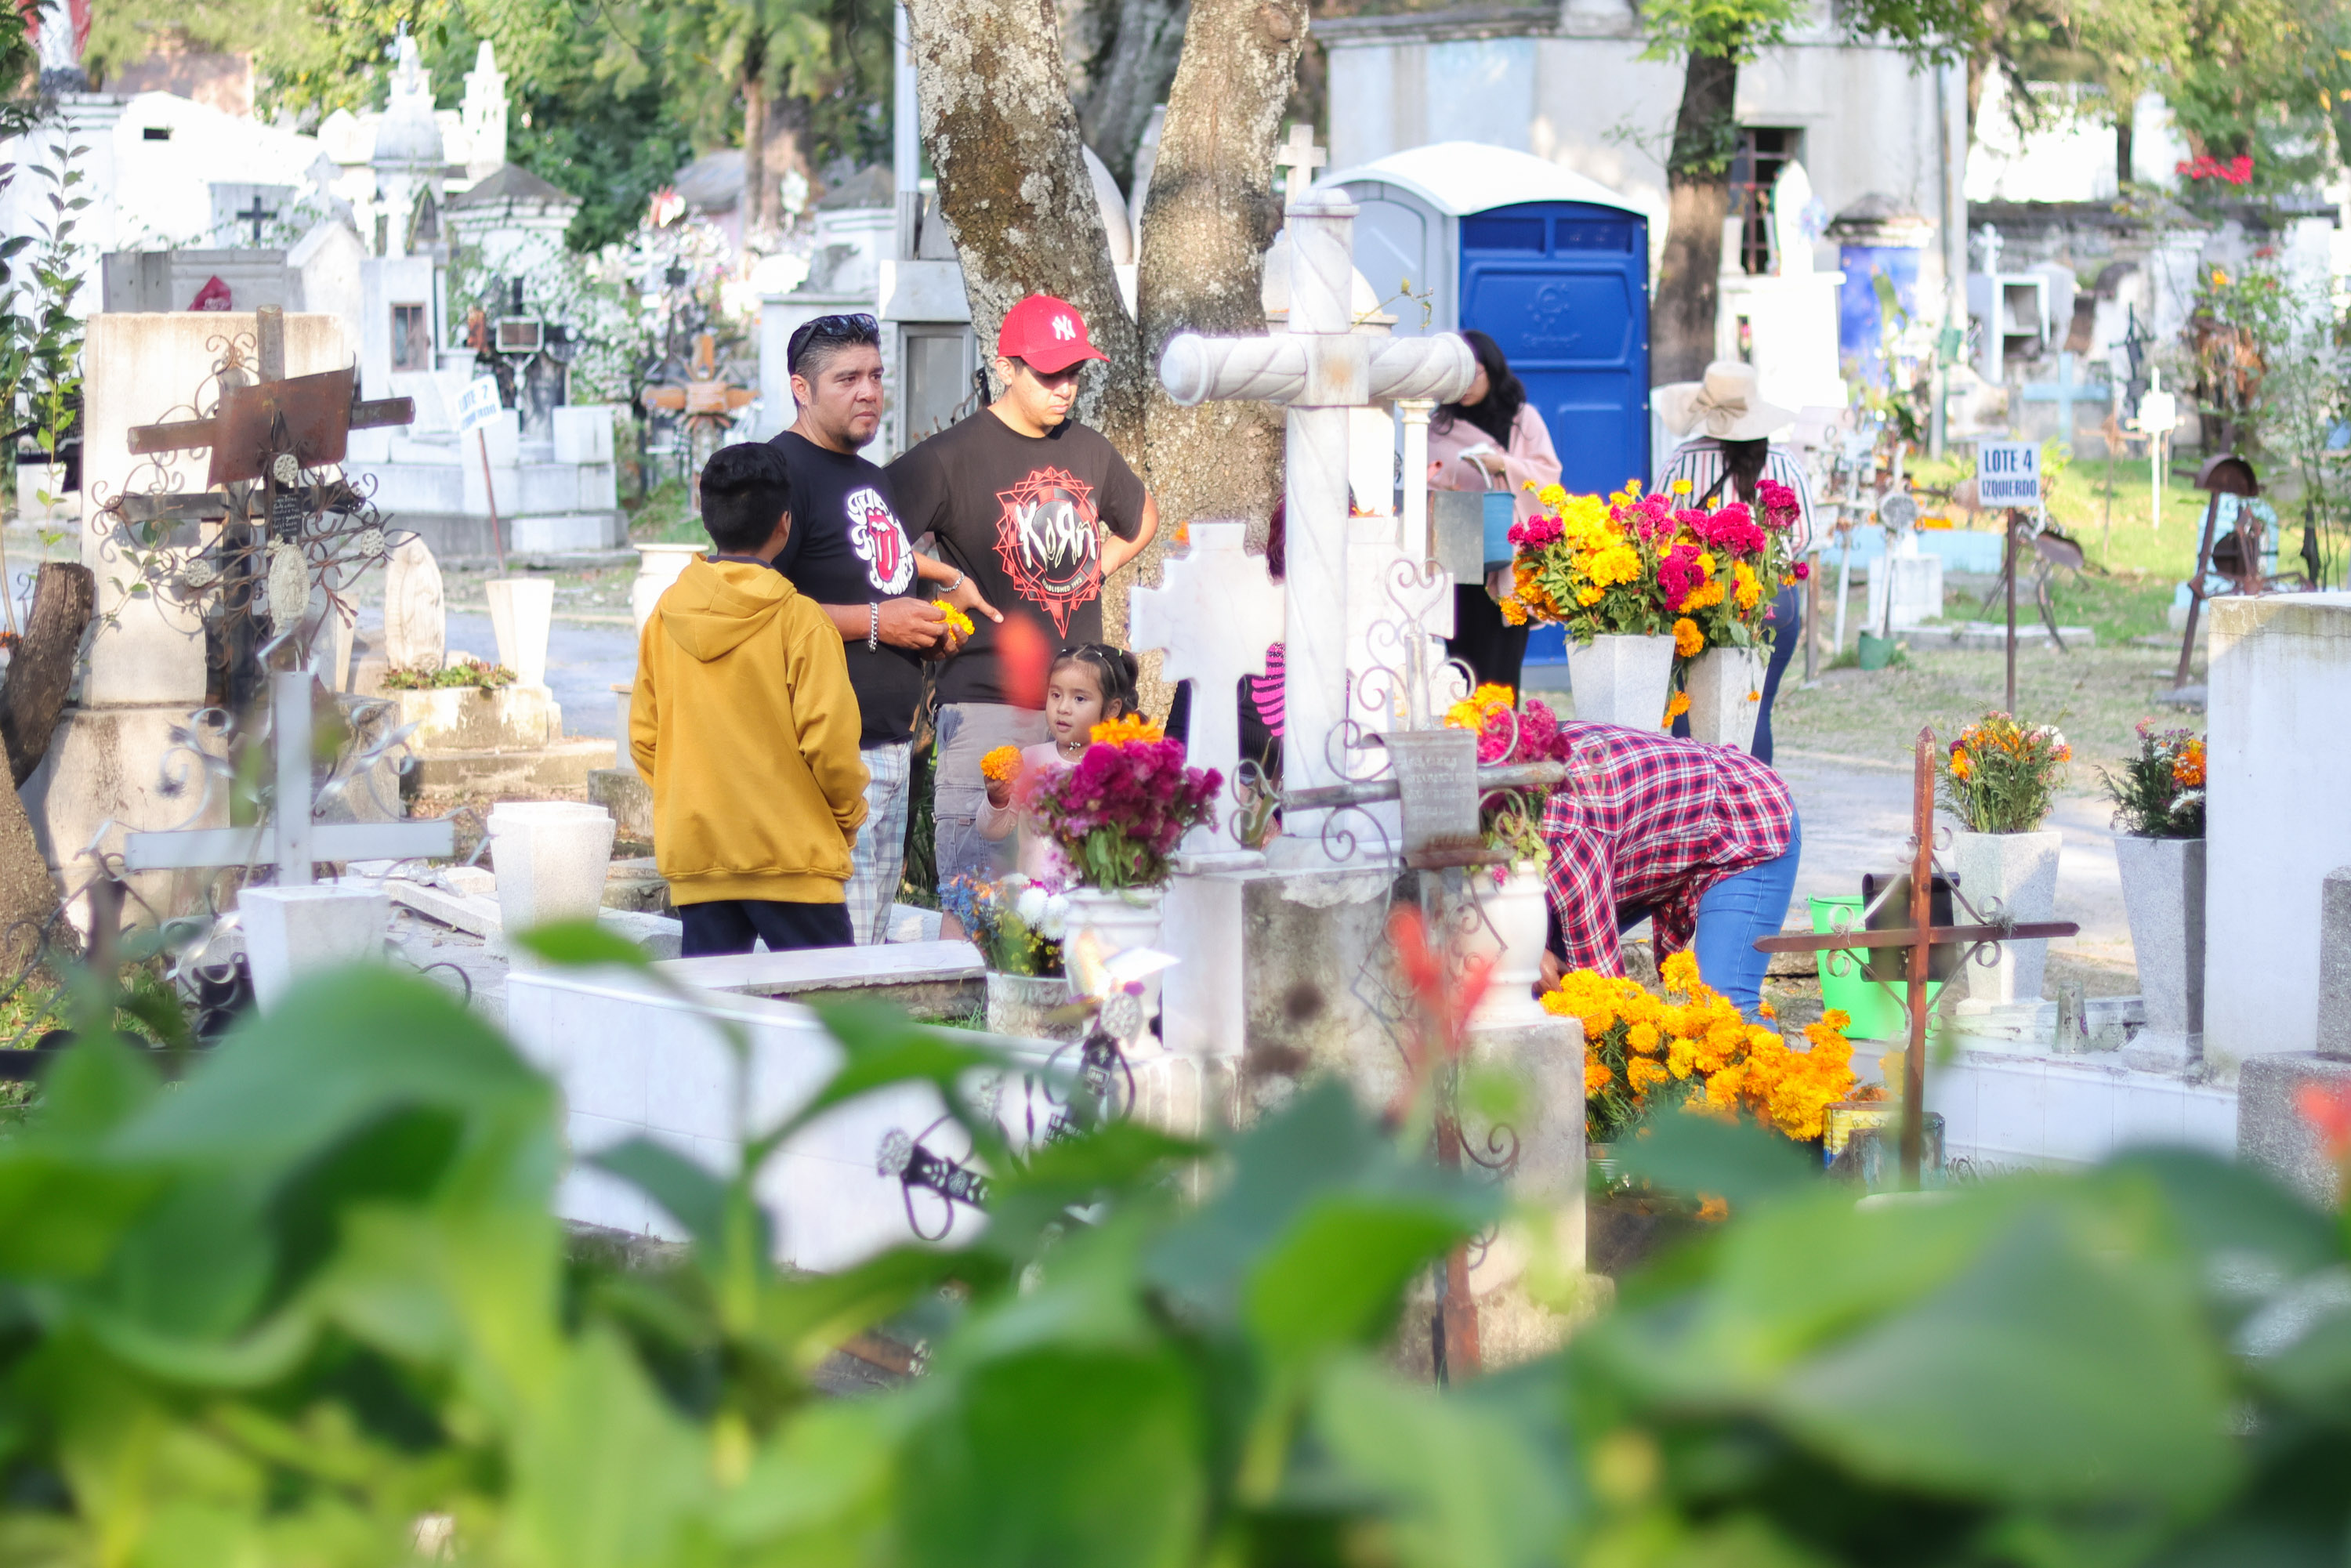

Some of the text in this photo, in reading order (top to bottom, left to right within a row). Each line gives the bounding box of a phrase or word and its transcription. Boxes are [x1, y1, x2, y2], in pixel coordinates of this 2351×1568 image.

[1984, 448, 2032, 473] LOTE 4
[1982, 480, 2037, 500] IZQUIERDO
